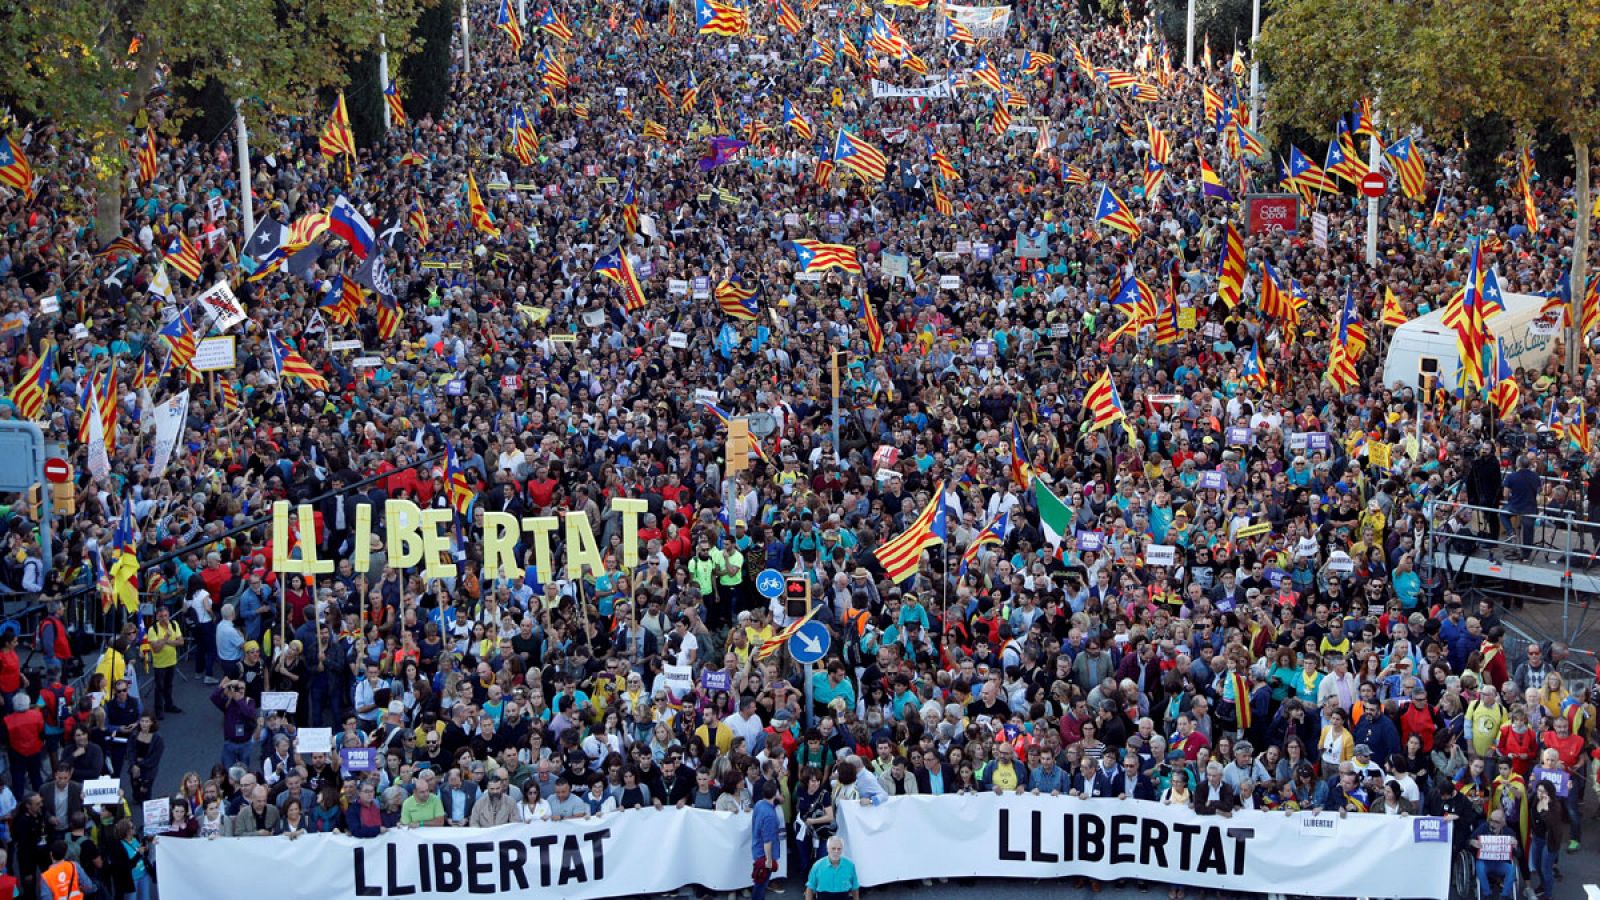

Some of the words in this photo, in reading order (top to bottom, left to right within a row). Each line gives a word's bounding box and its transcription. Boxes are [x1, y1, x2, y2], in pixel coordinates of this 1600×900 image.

[273, 498, 648, 583] LLIBERTAT
[347, 750, 369, 761] PROU
[999, 808, 1254, 875] LLIBERTAT
[1303, 819, 1334, 828] LLIBERTAT
[1419, 820, 1441, 831] PROU
[353, 828, 611, 897] LLIBERTAT
